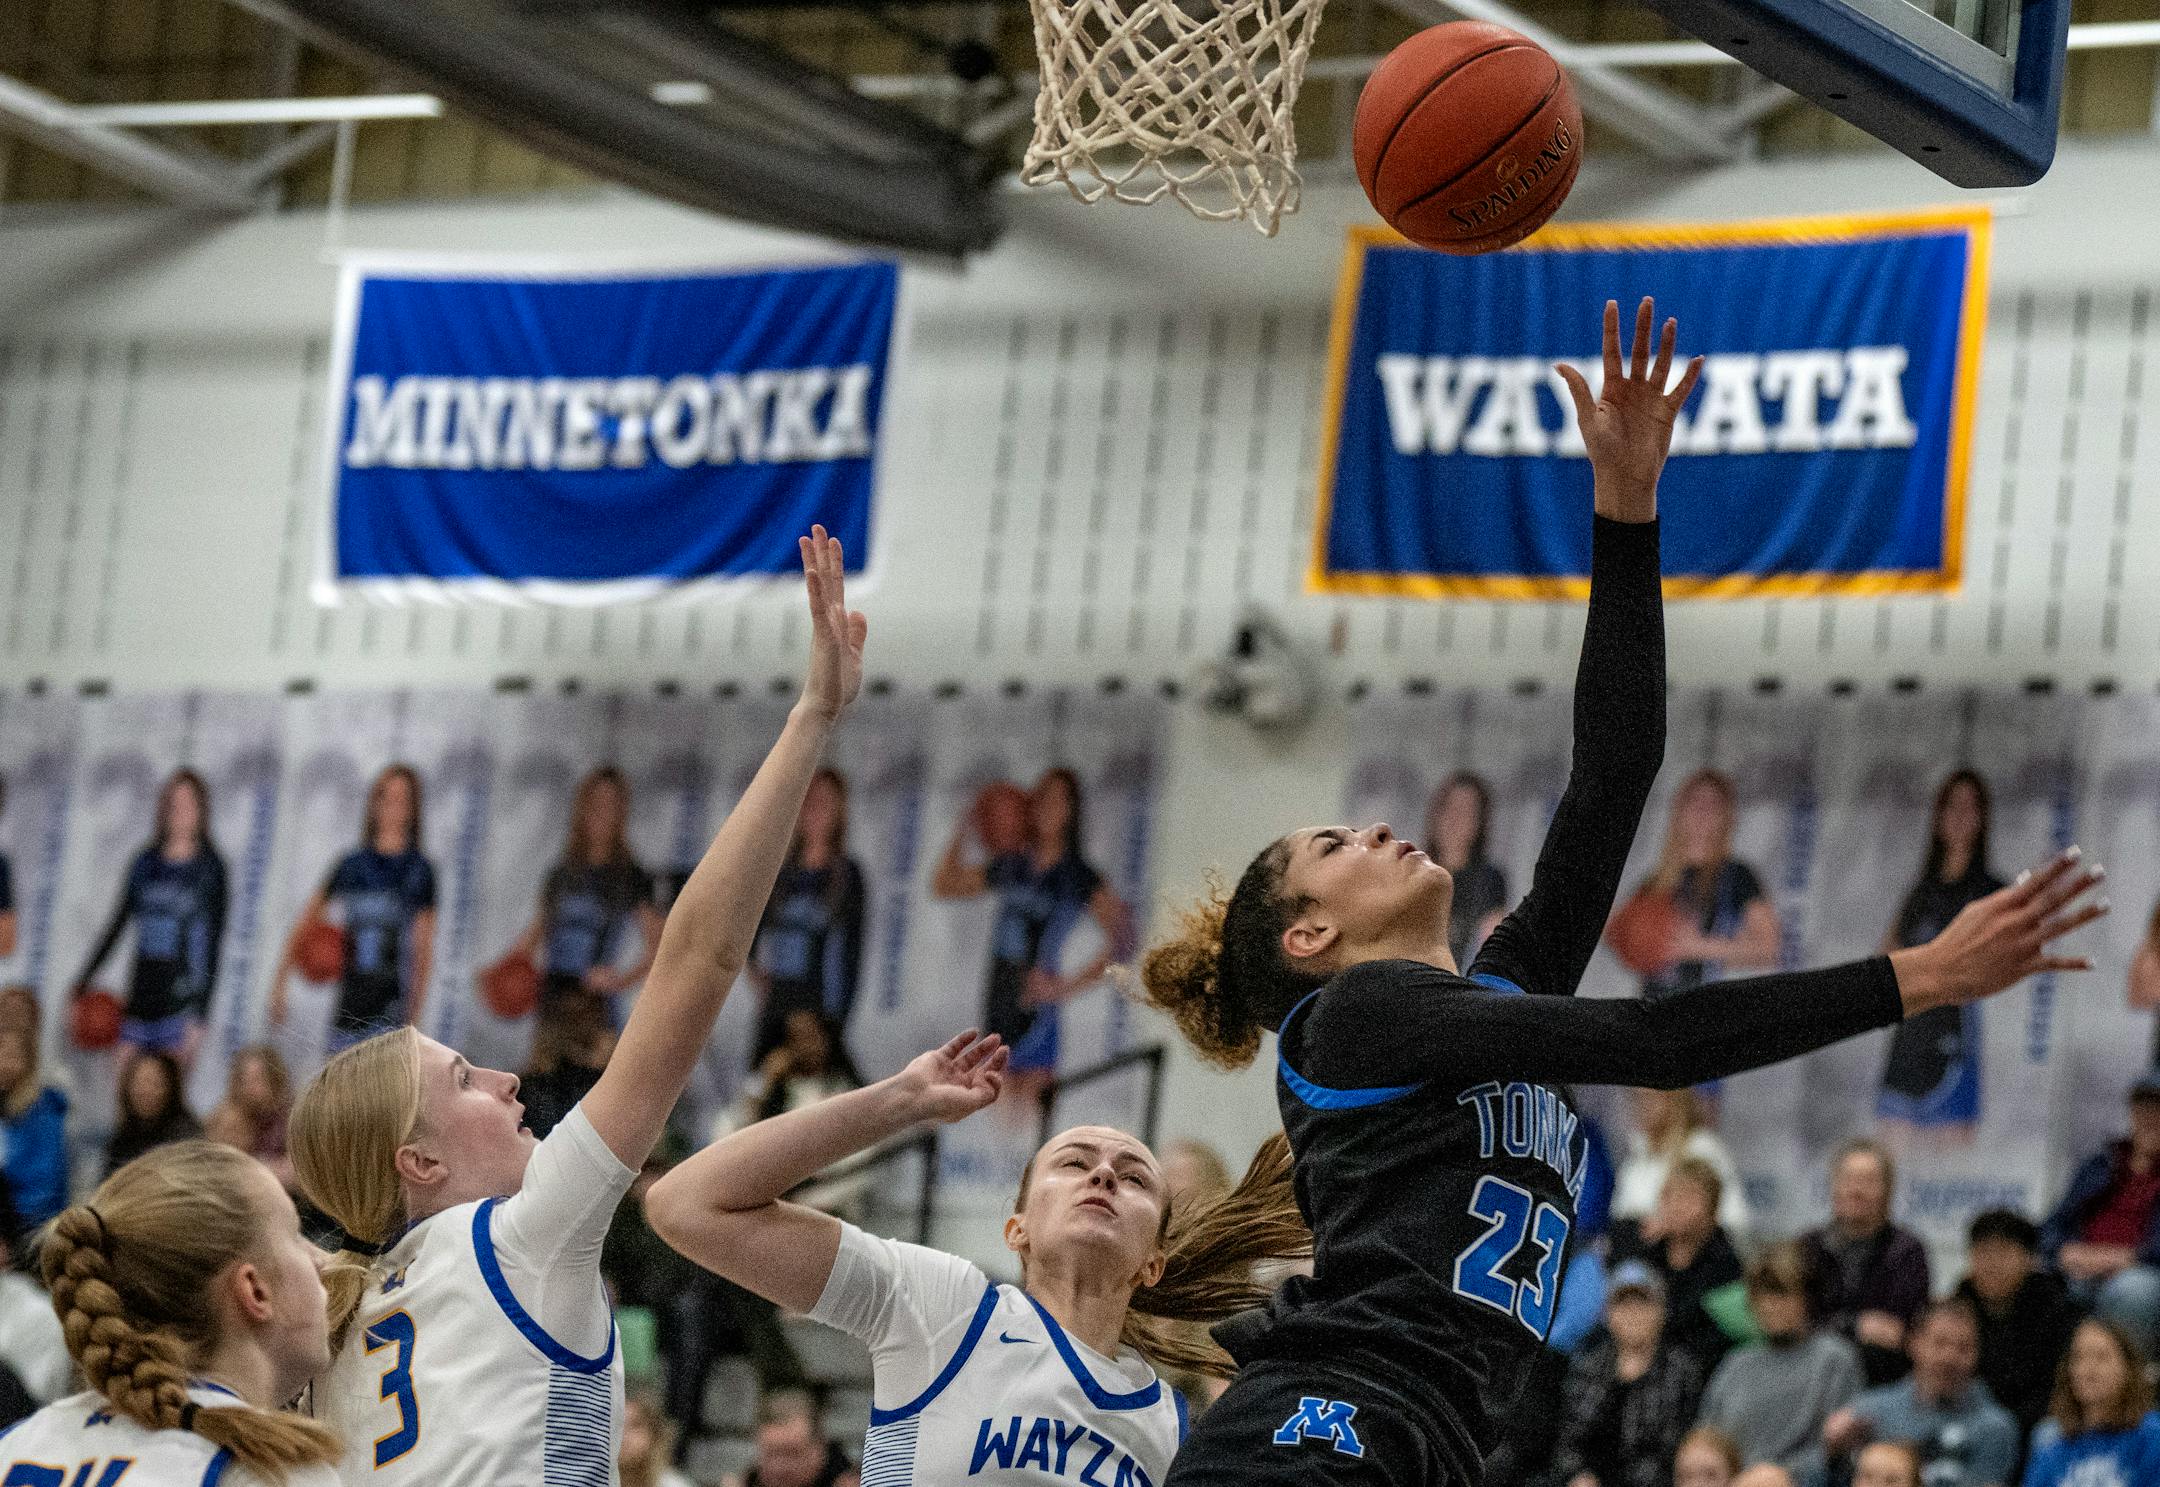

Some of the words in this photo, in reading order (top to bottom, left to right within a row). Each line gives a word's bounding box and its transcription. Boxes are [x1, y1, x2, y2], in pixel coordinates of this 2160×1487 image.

[1448, 117, 1573, 233] SPALDING
[347, 362, 872, 471] MINNETONKA
[1453, 1174, 1571, 1342] 23
[364, 1307, 417, 1471] 3
[1273, 1397, 1365, 1458] M
